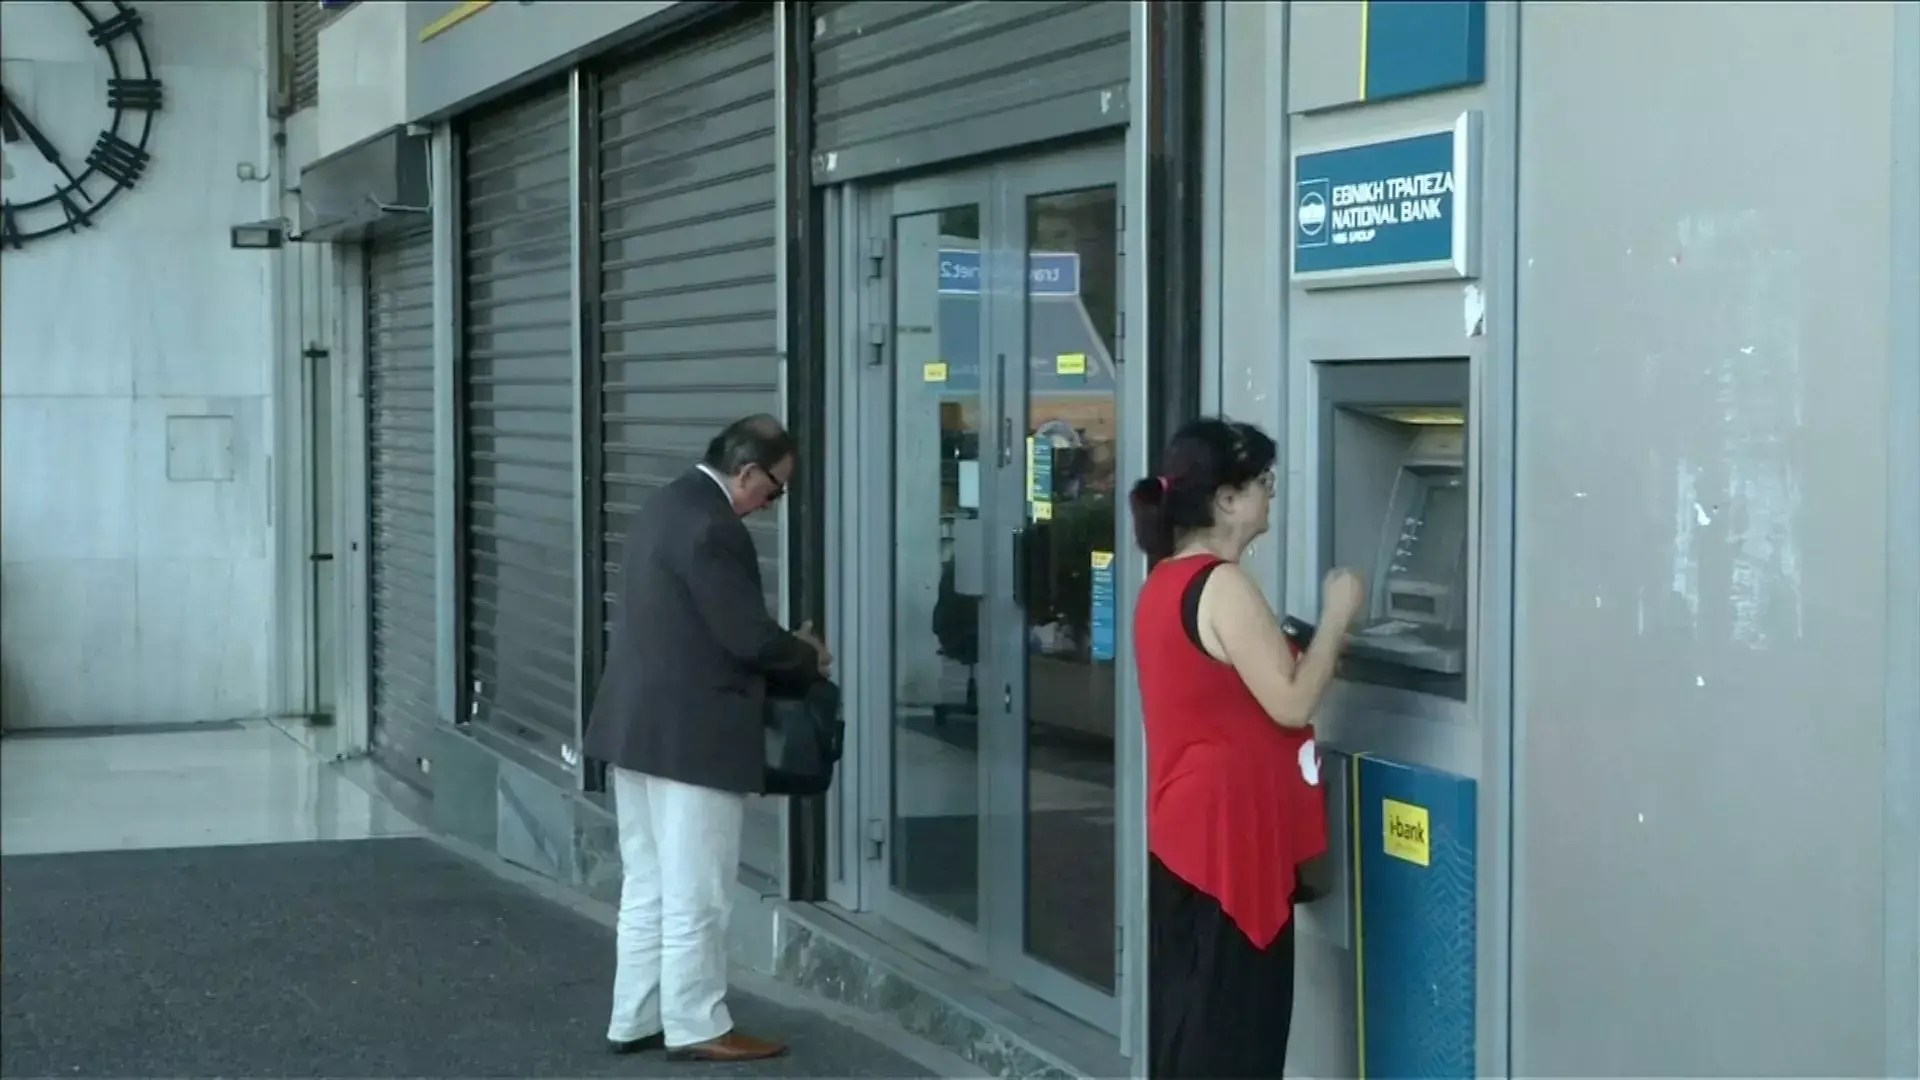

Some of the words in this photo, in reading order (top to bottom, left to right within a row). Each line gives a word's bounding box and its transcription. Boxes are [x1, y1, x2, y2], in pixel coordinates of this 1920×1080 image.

[1386, 172, 1453, 198] ΤΡΑΠΕΖΑ
[1332, 204, 1398, 229] NATIONAL
[1401, 197, 1442, 222] BANK
[1389, 814, 1425, 843] i-bank
